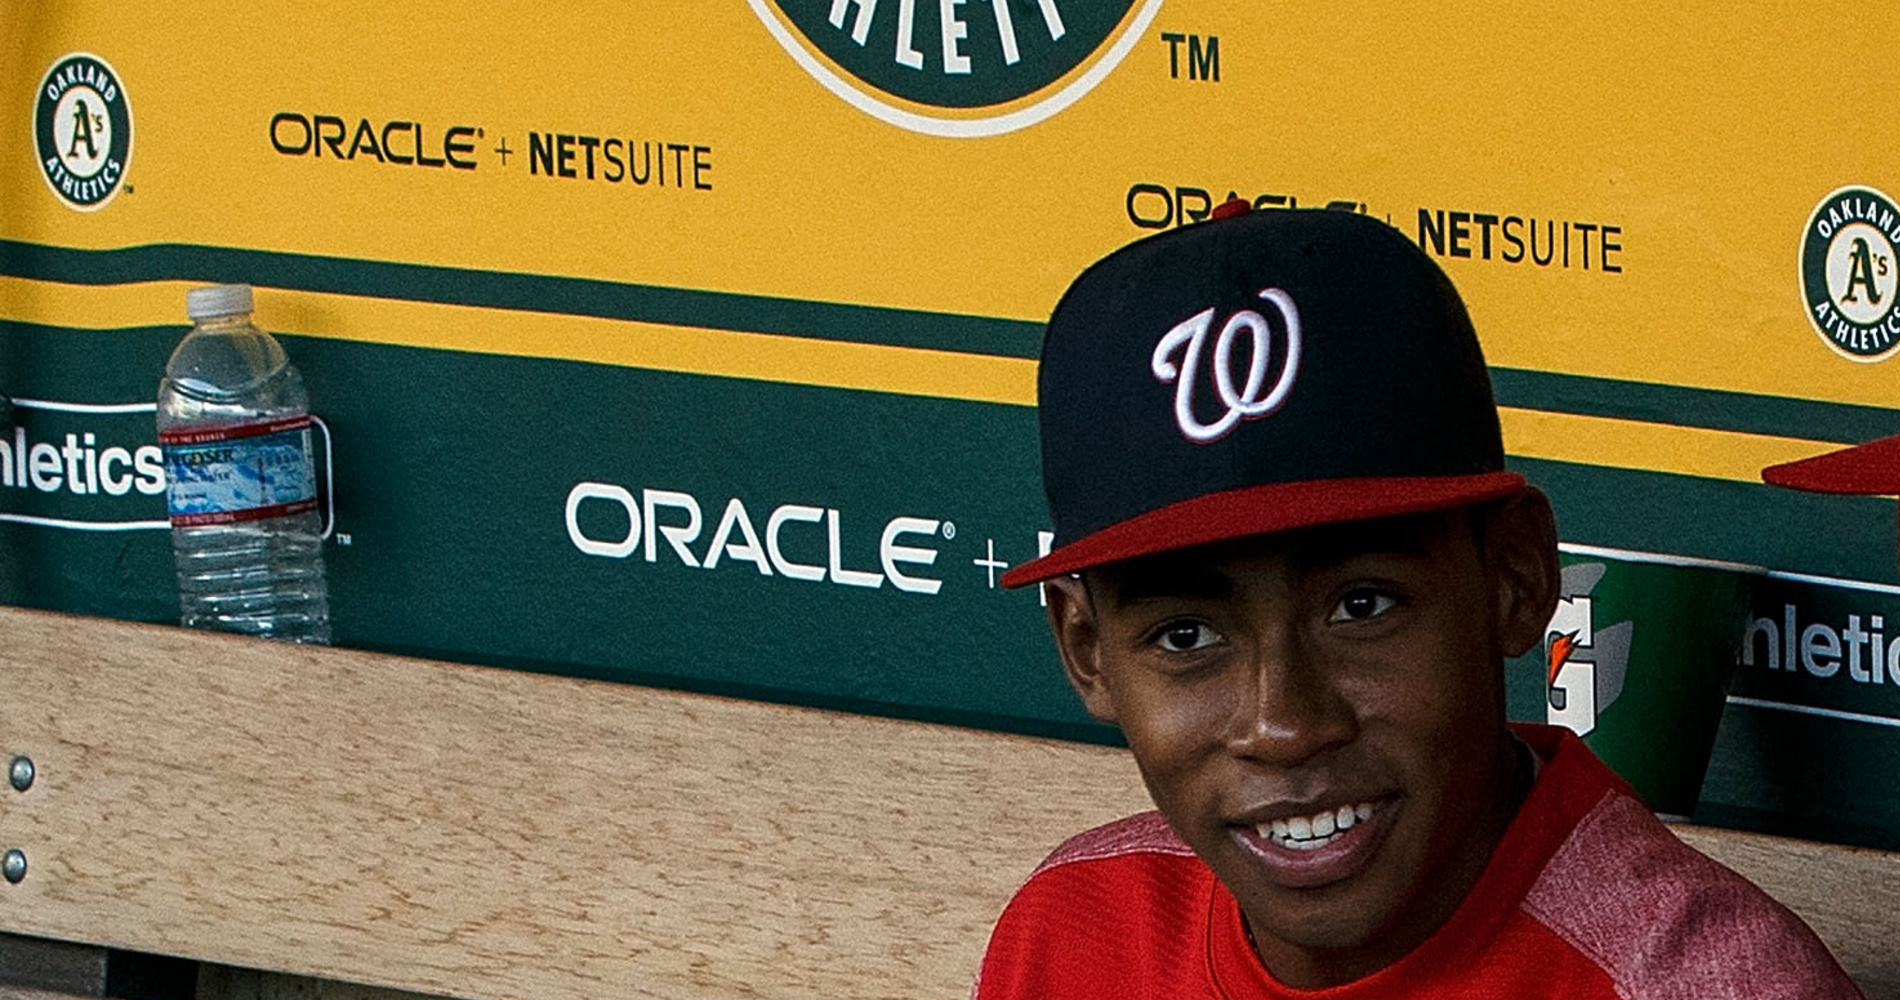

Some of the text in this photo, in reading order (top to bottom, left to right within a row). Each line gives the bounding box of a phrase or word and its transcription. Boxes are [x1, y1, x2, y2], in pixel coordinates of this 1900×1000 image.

[47, 63, 116, 103] OAKLAND
[1161, 33, 1220, 82] TM
[46, 156, 120, 200] ATHLETICS
[529, 132, 713, 191] NETSUITE
[1417, 208, 1623, 273] NETSUITE
[1152, 287, 1300, 441] W
